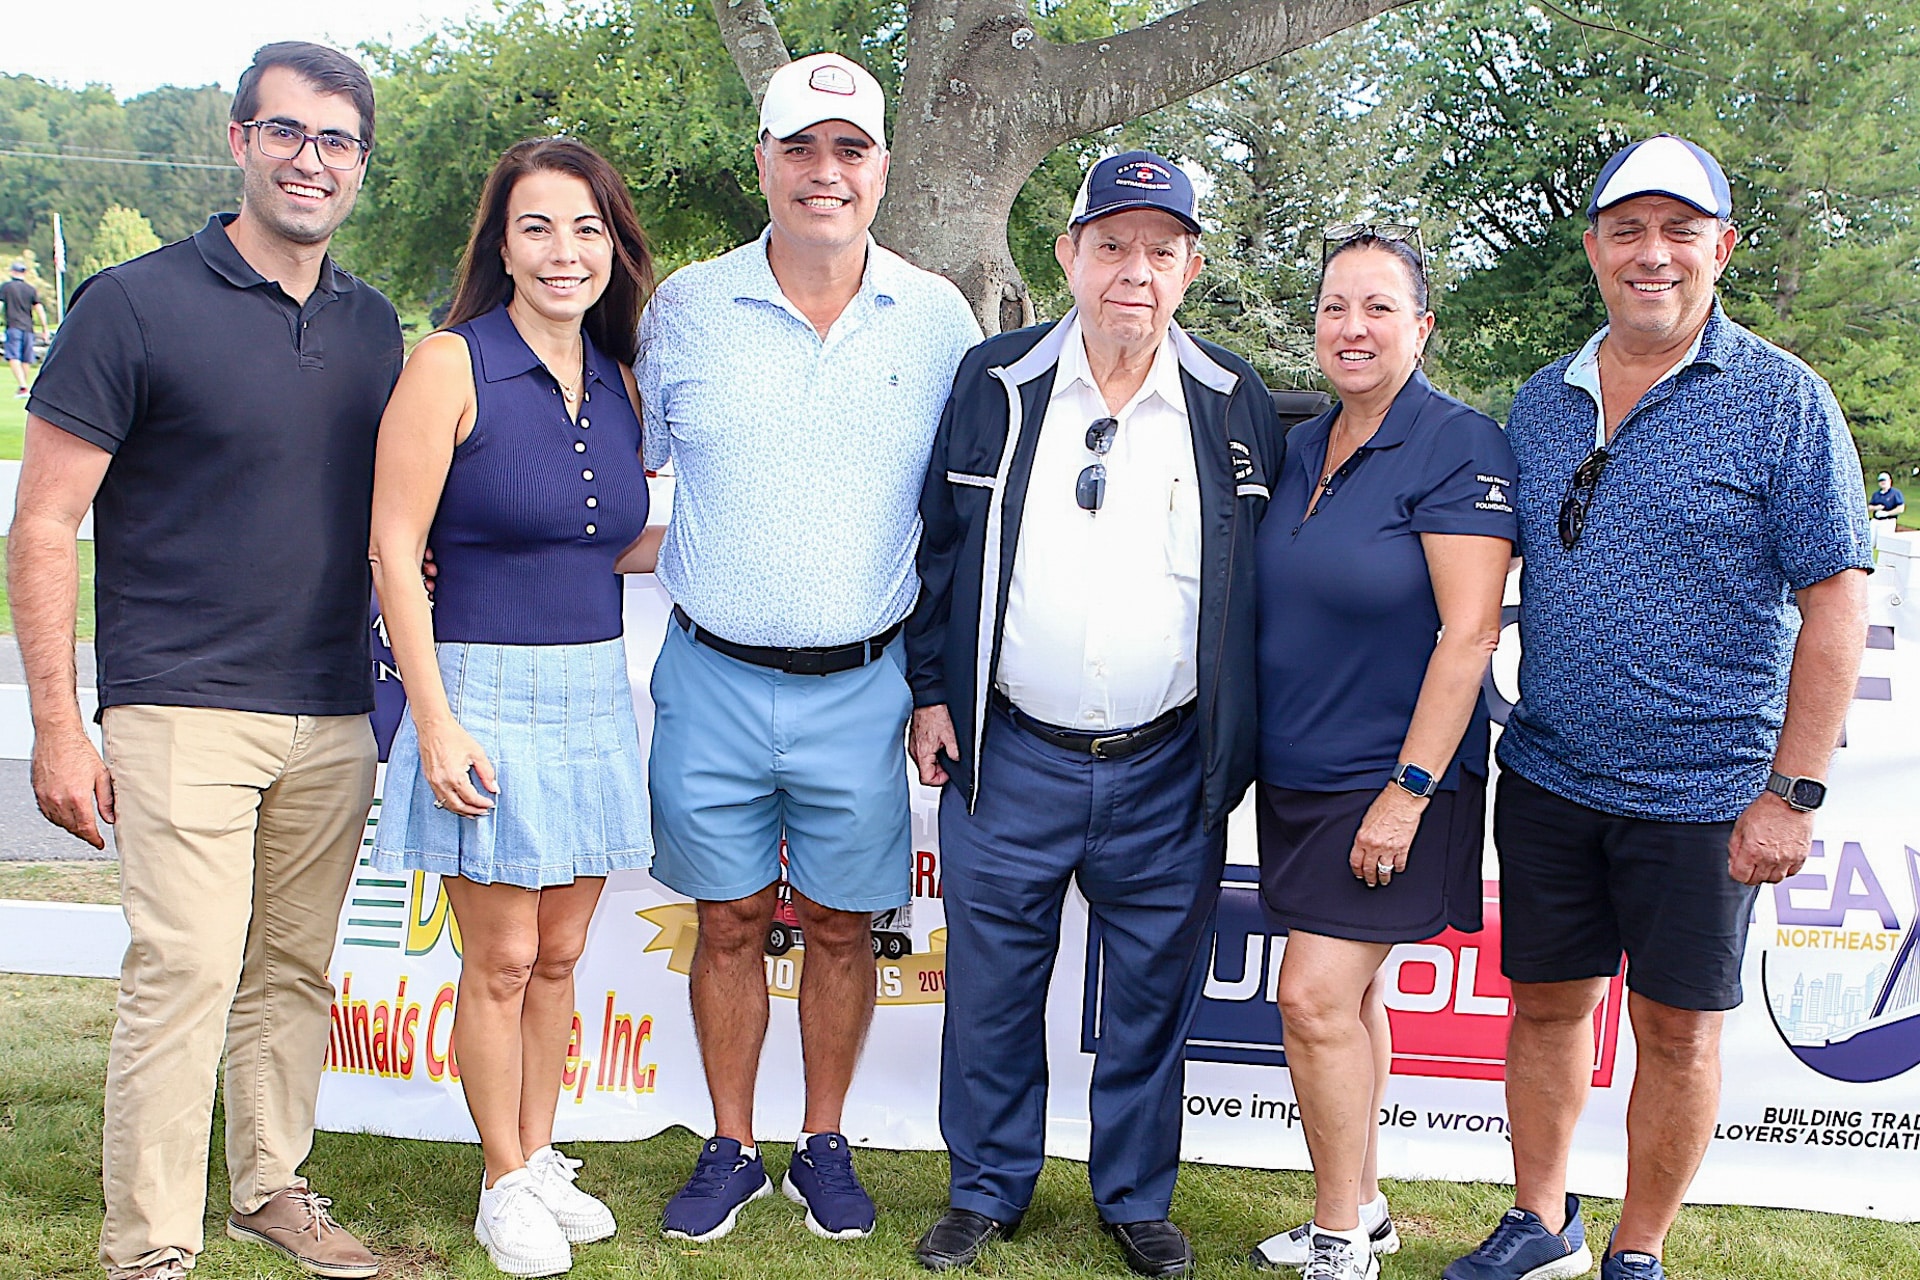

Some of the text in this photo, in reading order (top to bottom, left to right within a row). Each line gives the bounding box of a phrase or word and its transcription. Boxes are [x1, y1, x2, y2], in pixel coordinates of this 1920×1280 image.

[1775, 928, 1901, 951] NORTHEAST
[918, 970, 946, 993] 201
[595, 989, 658, 1095] Inc.
[1763, 1107, 1863, 1128] BUILDING
[1713, 1123, 1920, 1150] LOYERS' ASSOCIATI
